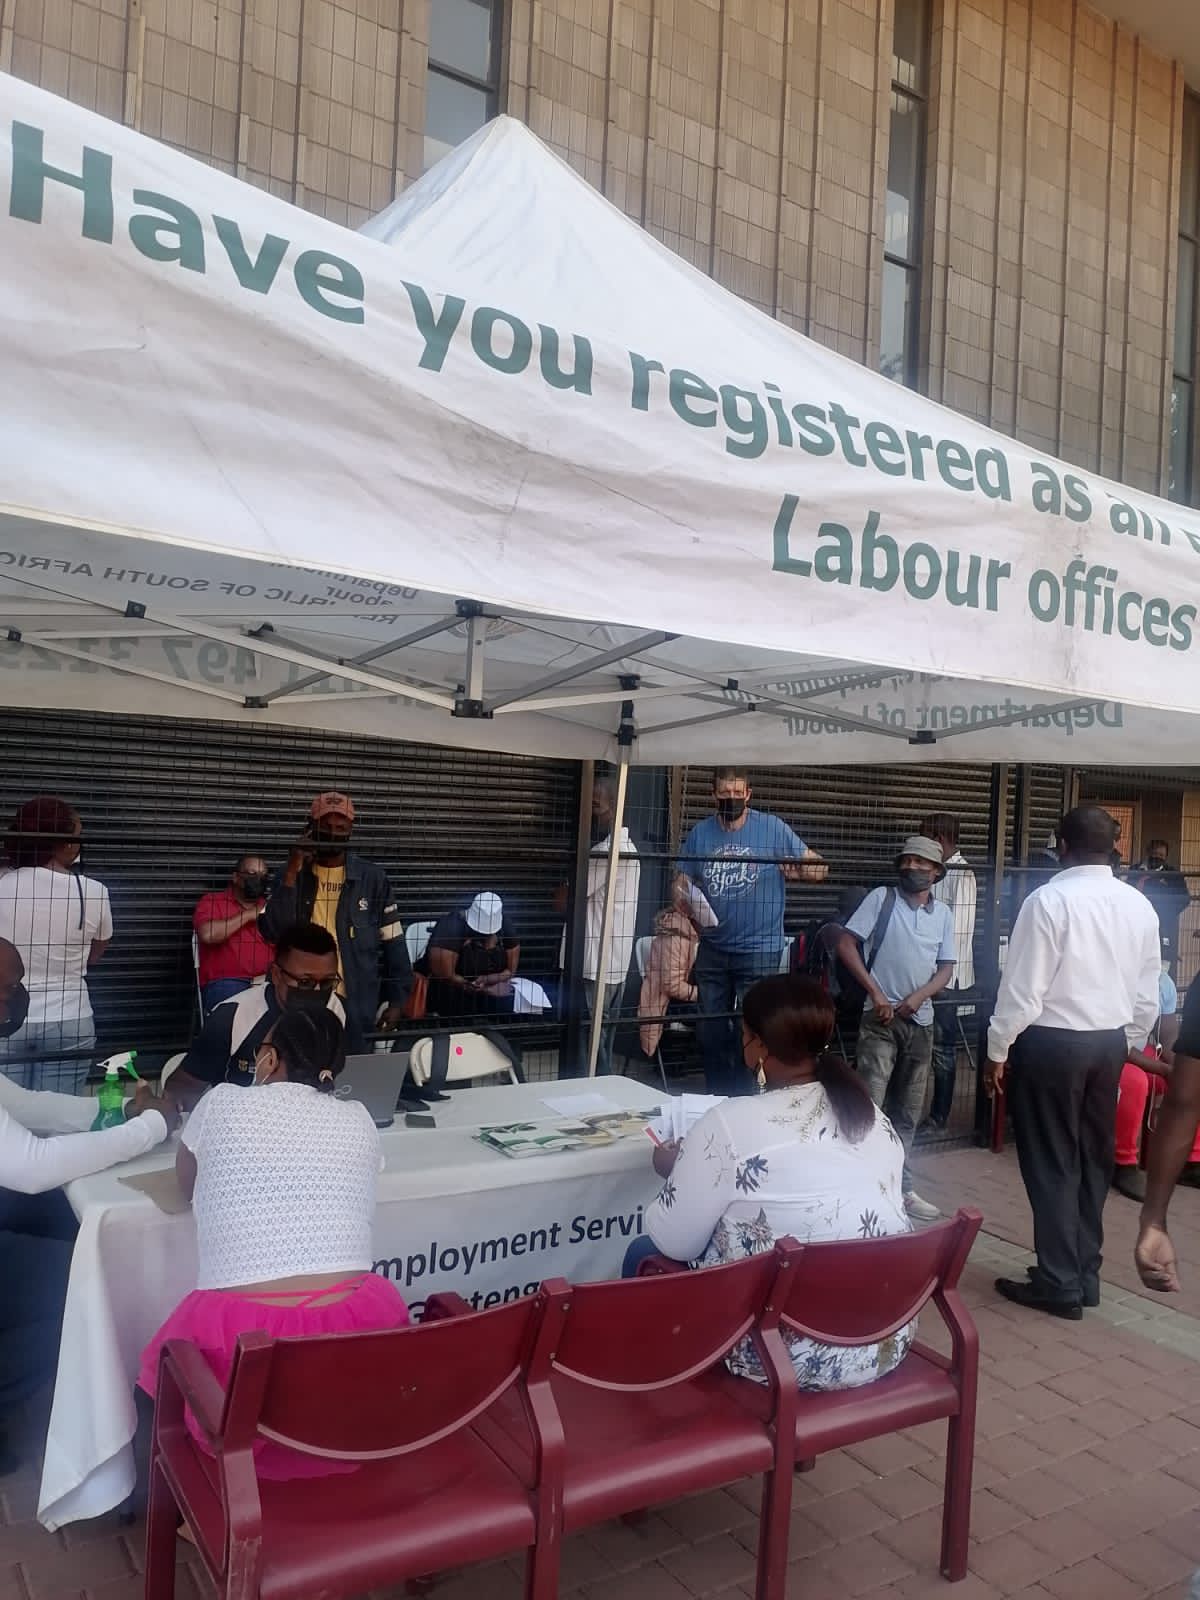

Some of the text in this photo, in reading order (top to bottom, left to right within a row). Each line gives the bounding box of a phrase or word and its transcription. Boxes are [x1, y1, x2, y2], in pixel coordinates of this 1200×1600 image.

[9, 120, 365, 324] Have
[401, 280, 593, 395] you
[629, 351, 1012, 501] registered
[1030, 461, 1092, 523] as
[772, 493, 1198, 652] Labour offices
[372, 1204, 644, 1286] mployment Servi
